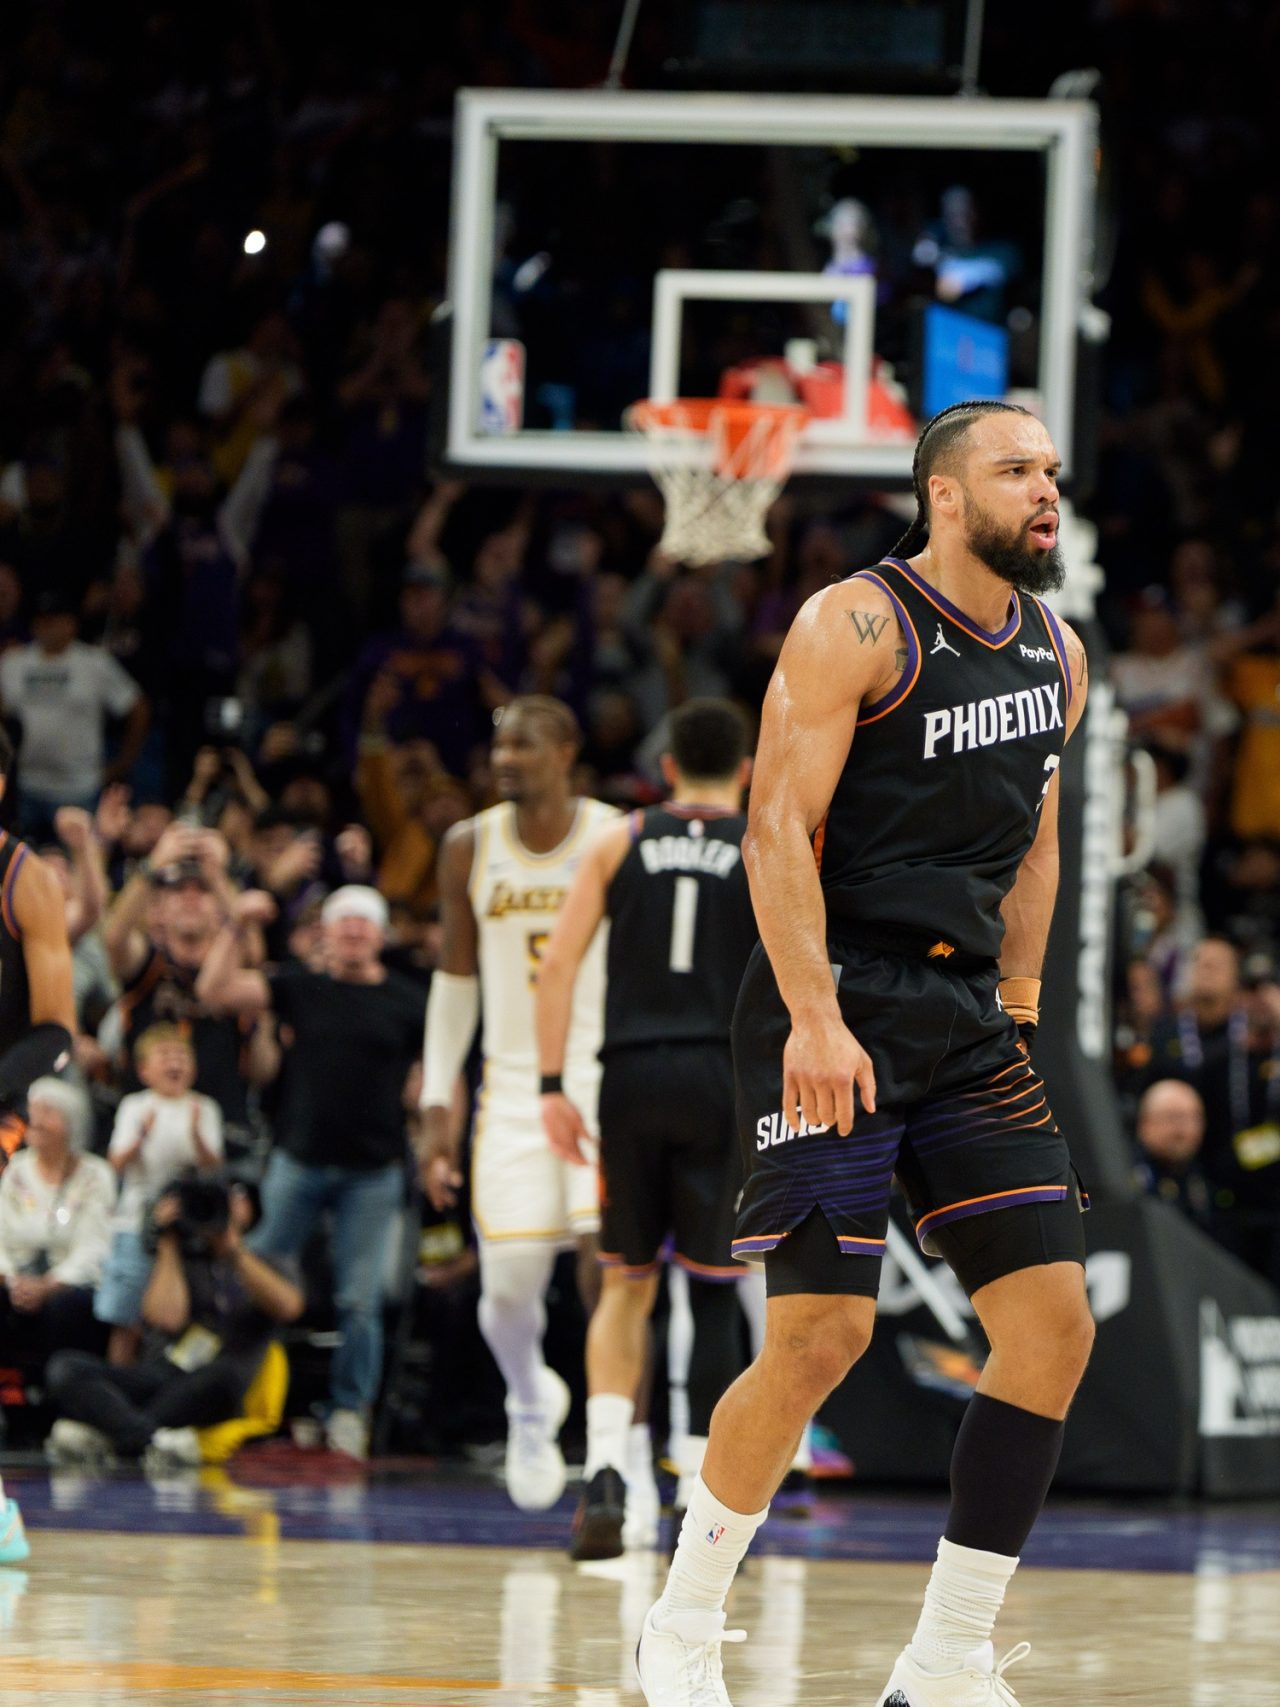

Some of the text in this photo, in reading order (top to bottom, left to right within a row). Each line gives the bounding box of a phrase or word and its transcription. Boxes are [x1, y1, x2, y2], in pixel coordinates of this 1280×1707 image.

[1018, 643, 1056, 663] PayPal
[922, 682, 1064, 760] PHOENIX
[669, 876, 698, 973] 1
